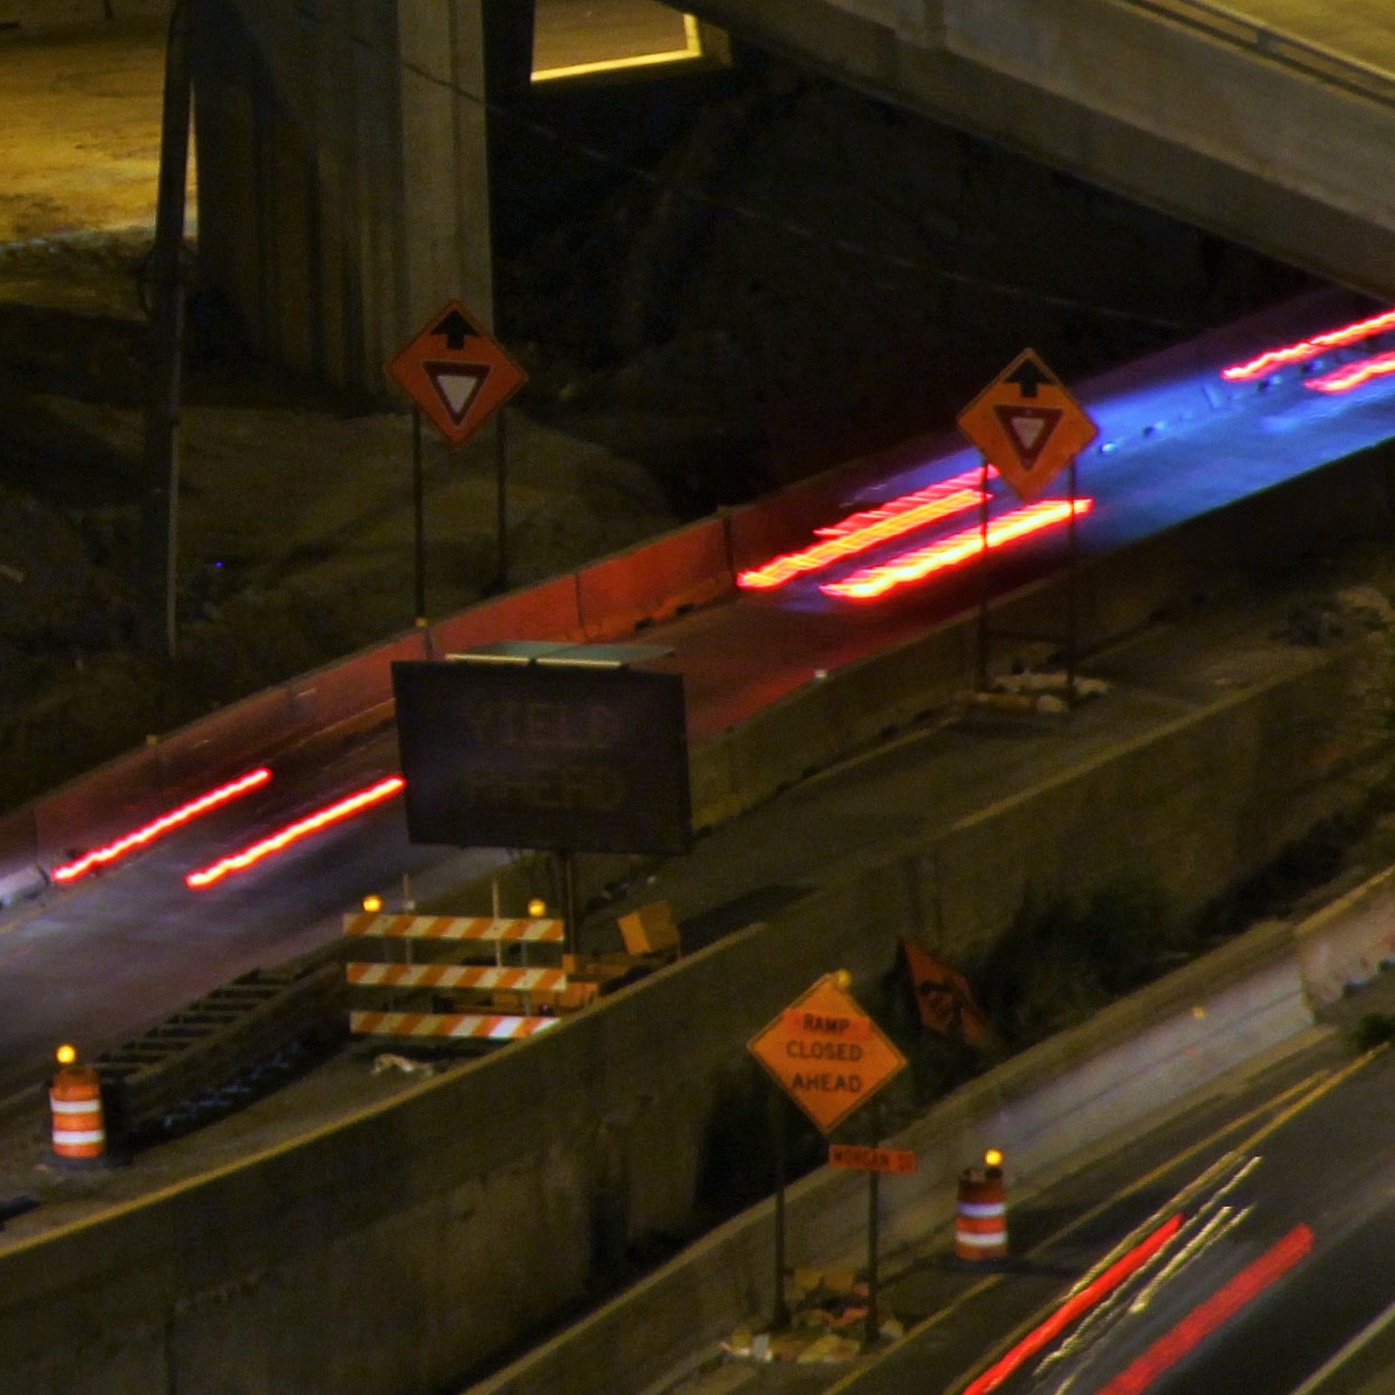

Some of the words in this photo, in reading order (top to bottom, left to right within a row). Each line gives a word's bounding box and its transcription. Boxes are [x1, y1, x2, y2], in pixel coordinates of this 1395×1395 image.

[803, 1013, 851, 1033] RAMP
[786, 1040, 864, 1062] CLOSED
[792, 1074, 862, 1093] AHEAD
